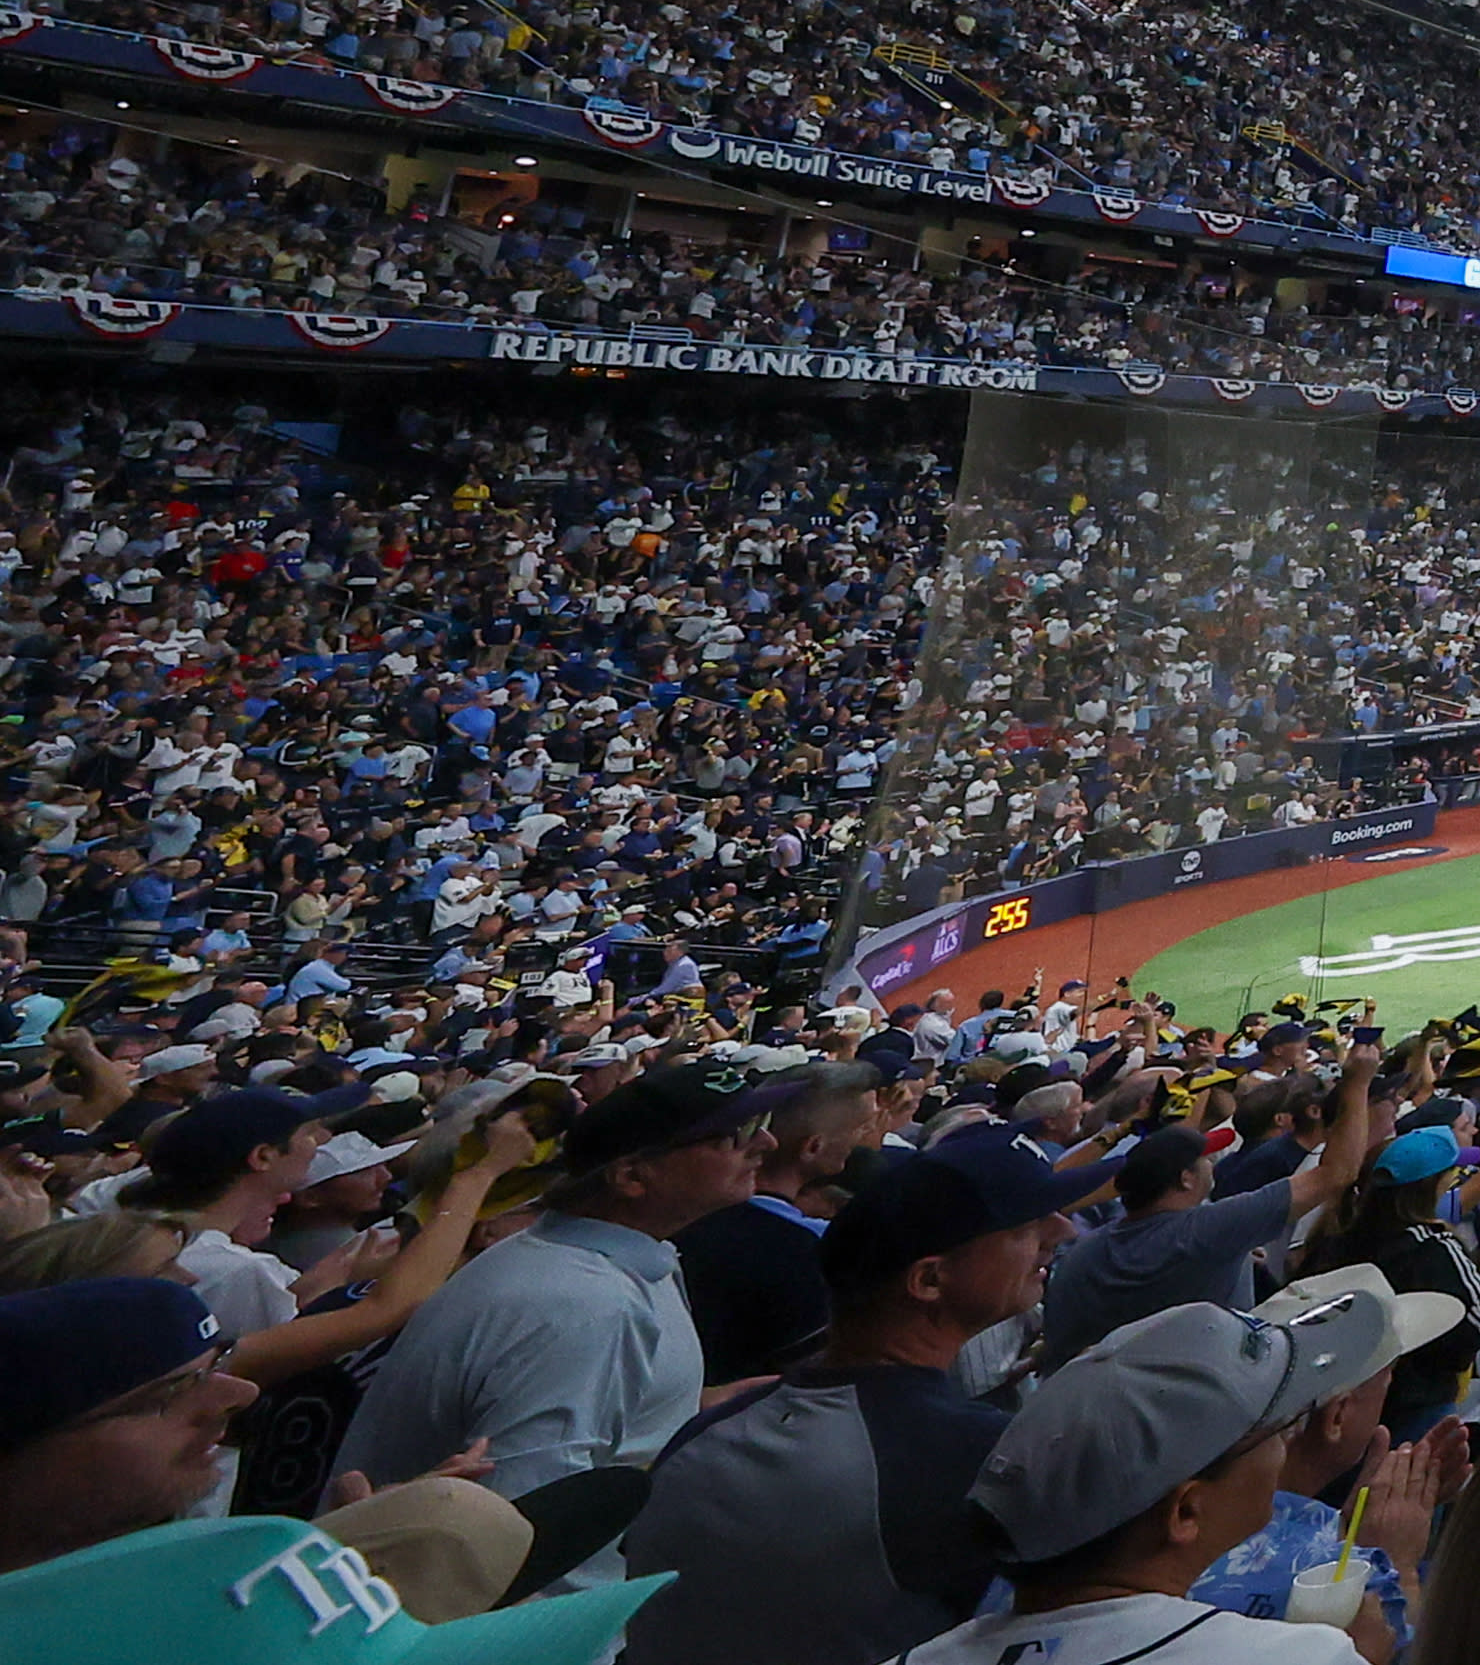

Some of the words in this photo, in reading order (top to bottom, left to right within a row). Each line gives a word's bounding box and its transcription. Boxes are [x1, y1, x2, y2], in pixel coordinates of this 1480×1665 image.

[725, 141, 829, 177] Webull
[837, 160, 913, 192] Suite
[918, 173, 993, 203] Level
[490, 335, 699, 371] REPUBLIC
[705, 348, 813, 378] BANK
[815, 353, 936, 384] DRAFT
[940, 361, 1038, 391] ROOM
[1331, 818, 1413, 846] Booking.com
[229, 1532, 402, 1638] TB
